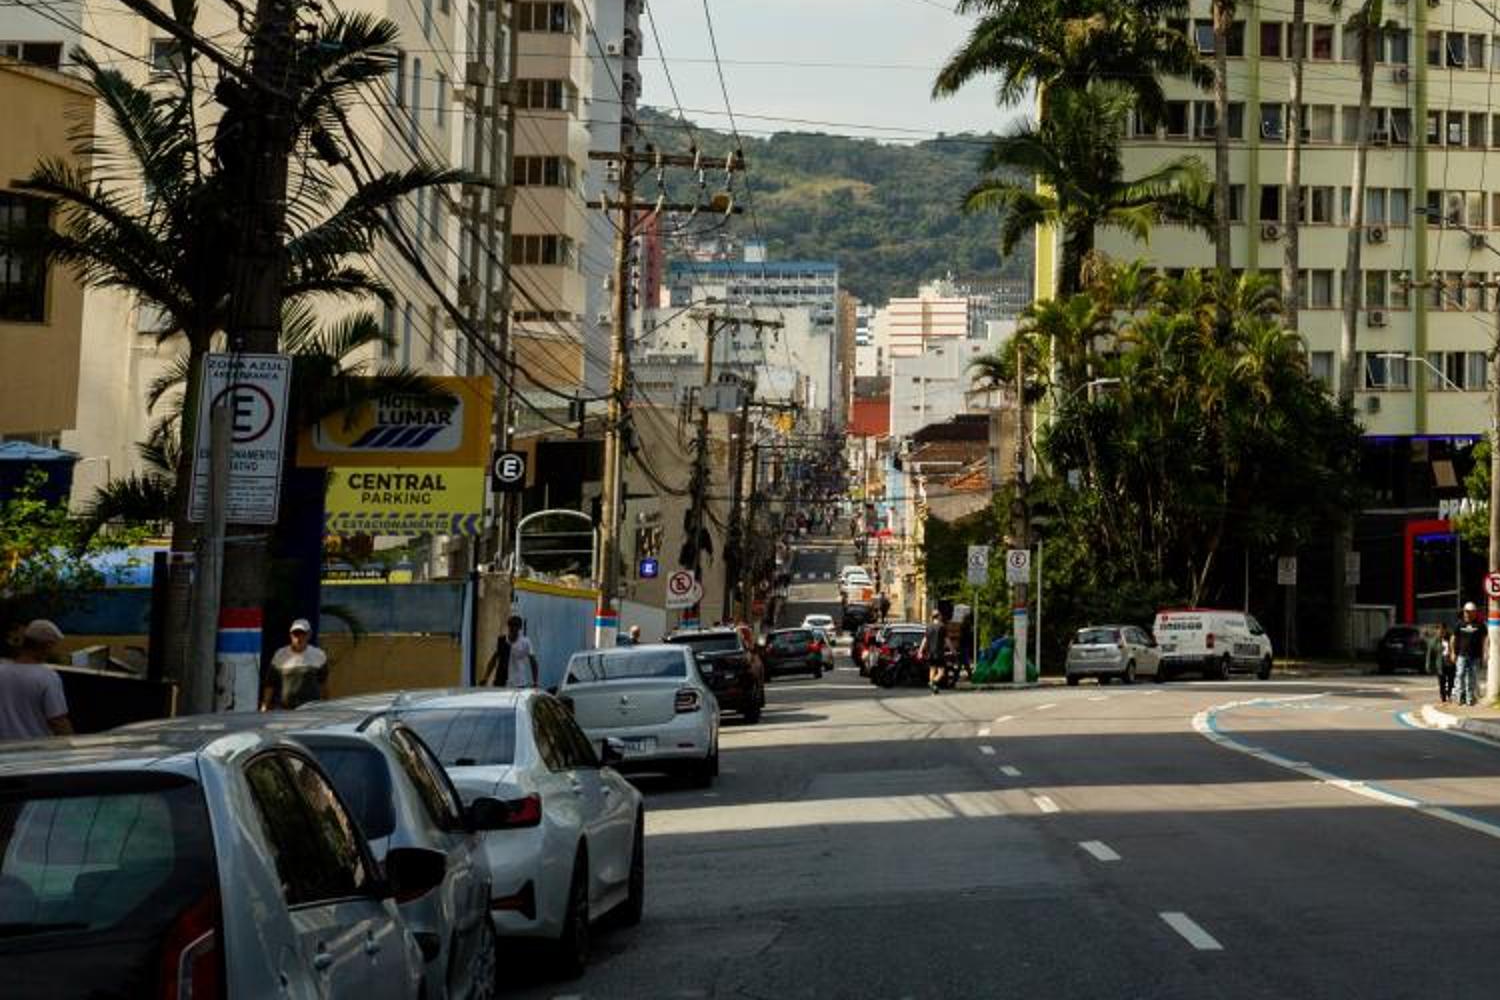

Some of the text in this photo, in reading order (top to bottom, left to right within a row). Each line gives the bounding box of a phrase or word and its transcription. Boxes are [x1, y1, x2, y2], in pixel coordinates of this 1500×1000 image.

[378, 411, 452, 425] LUMAR
[503, 460, 517, 477] E
[348, 473, 446, 491] CENTRAL
[361, 492, 431, 504] PARKING
[342, 520, 449, 530] ESTACIONAMENTO
